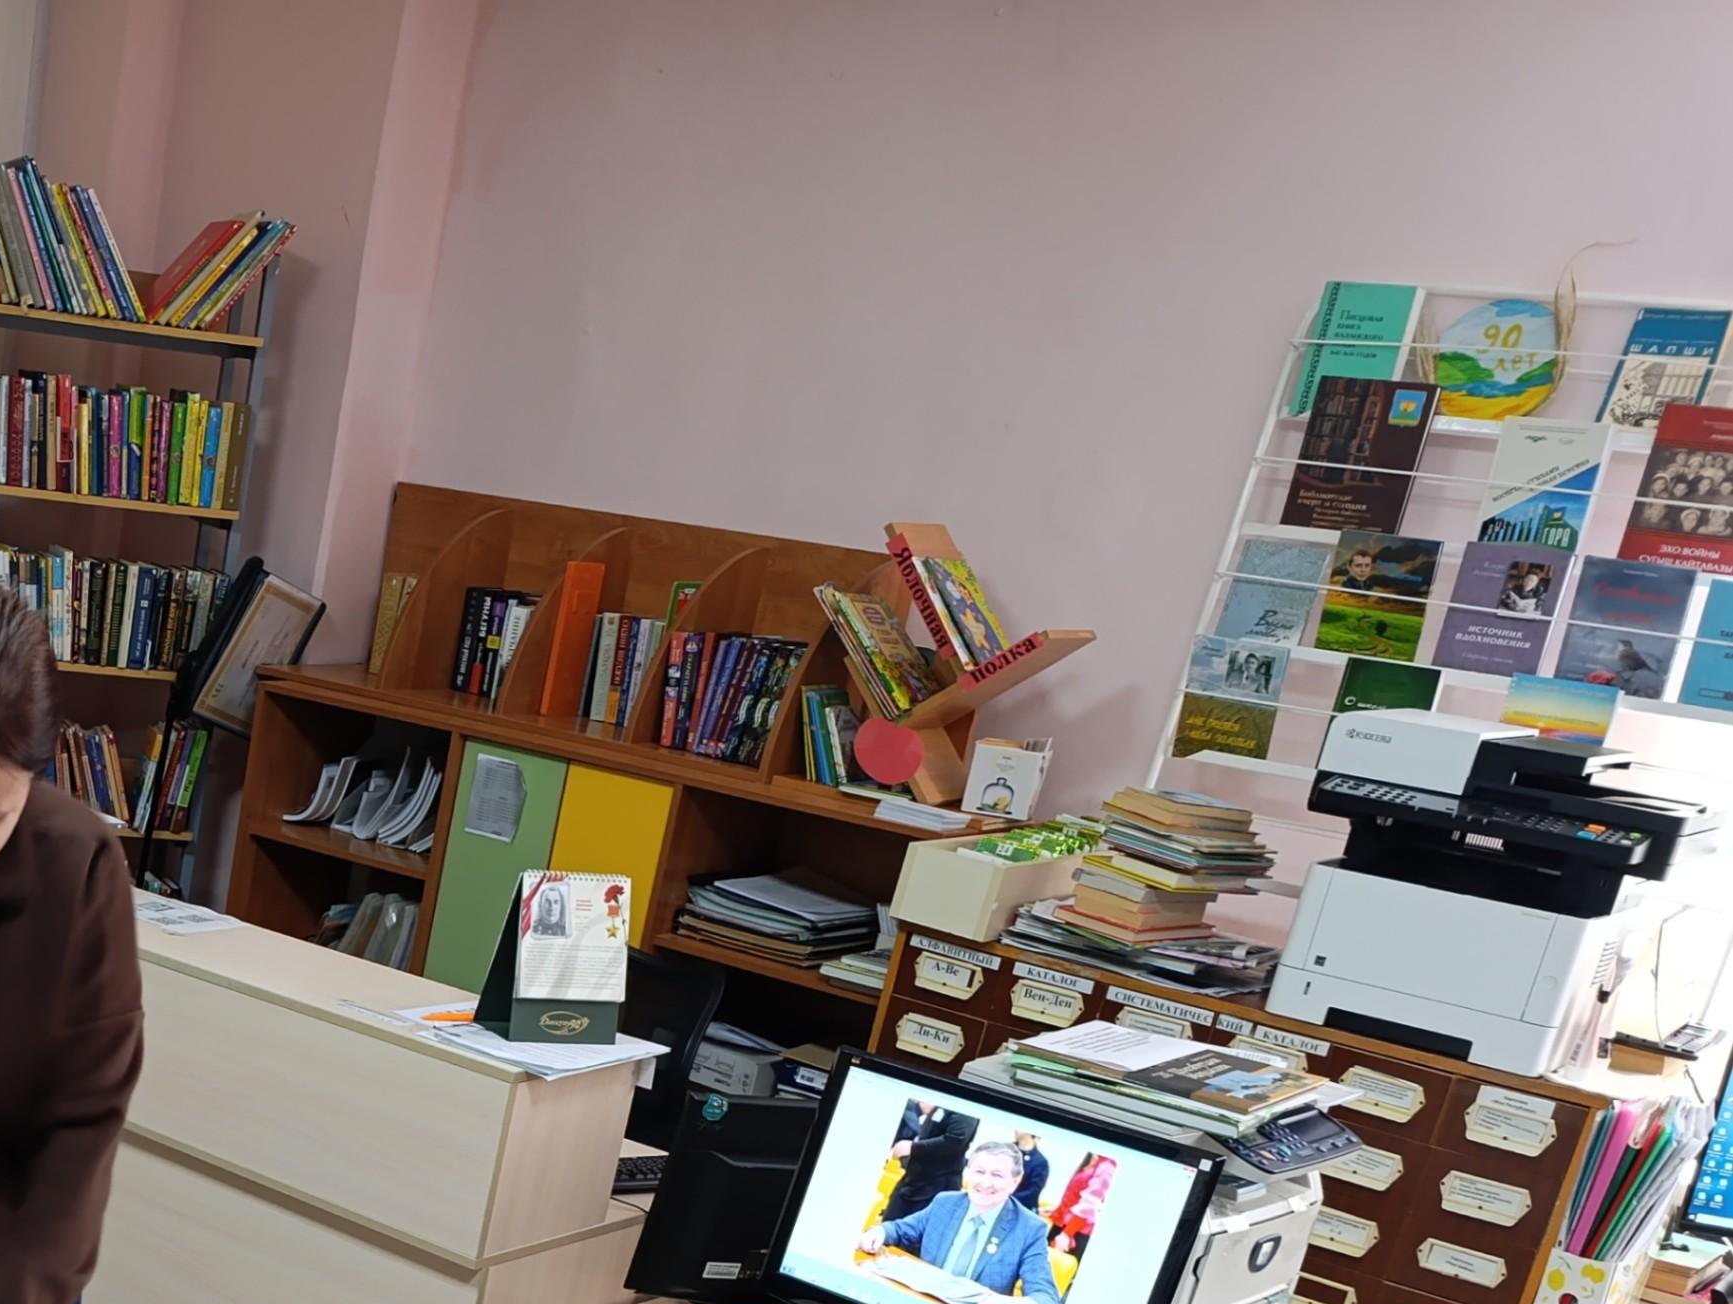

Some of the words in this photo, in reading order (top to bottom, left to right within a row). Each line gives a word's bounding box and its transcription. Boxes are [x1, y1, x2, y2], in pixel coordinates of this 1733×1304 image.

[1477, 322, 1524, 352] 90
[1629, 342, 1716, 357] ШАПШИ
[1492, 351, 1543, 373] лет
[1659, 543, 1680, 554] ЭХО
[1681, 545, 1722, 560] ВОЙНЫ
[893, 545, 950, 650] Яблочная
[479, 596, 492, 638] БЕГУНЫ
[1455, 632, 1532, 649] ВДОХНОВЕНИЯ
[1468, 624, 1524, 640] ИСТОЧНИК
[970, 636, 1038, 684] полка
[917, 937, 994, 967] АЛФАВИТНЫЙ
[1026, 967, 1081, 989] КАТАЛОГ
[1114, 990, 1213, 1025] СИСТЕМАТИЧЕС
[1219, 1016, 1244, 1033] КИЙ
[1262, 1030, 1321, 1054] КАТАЛОГ
